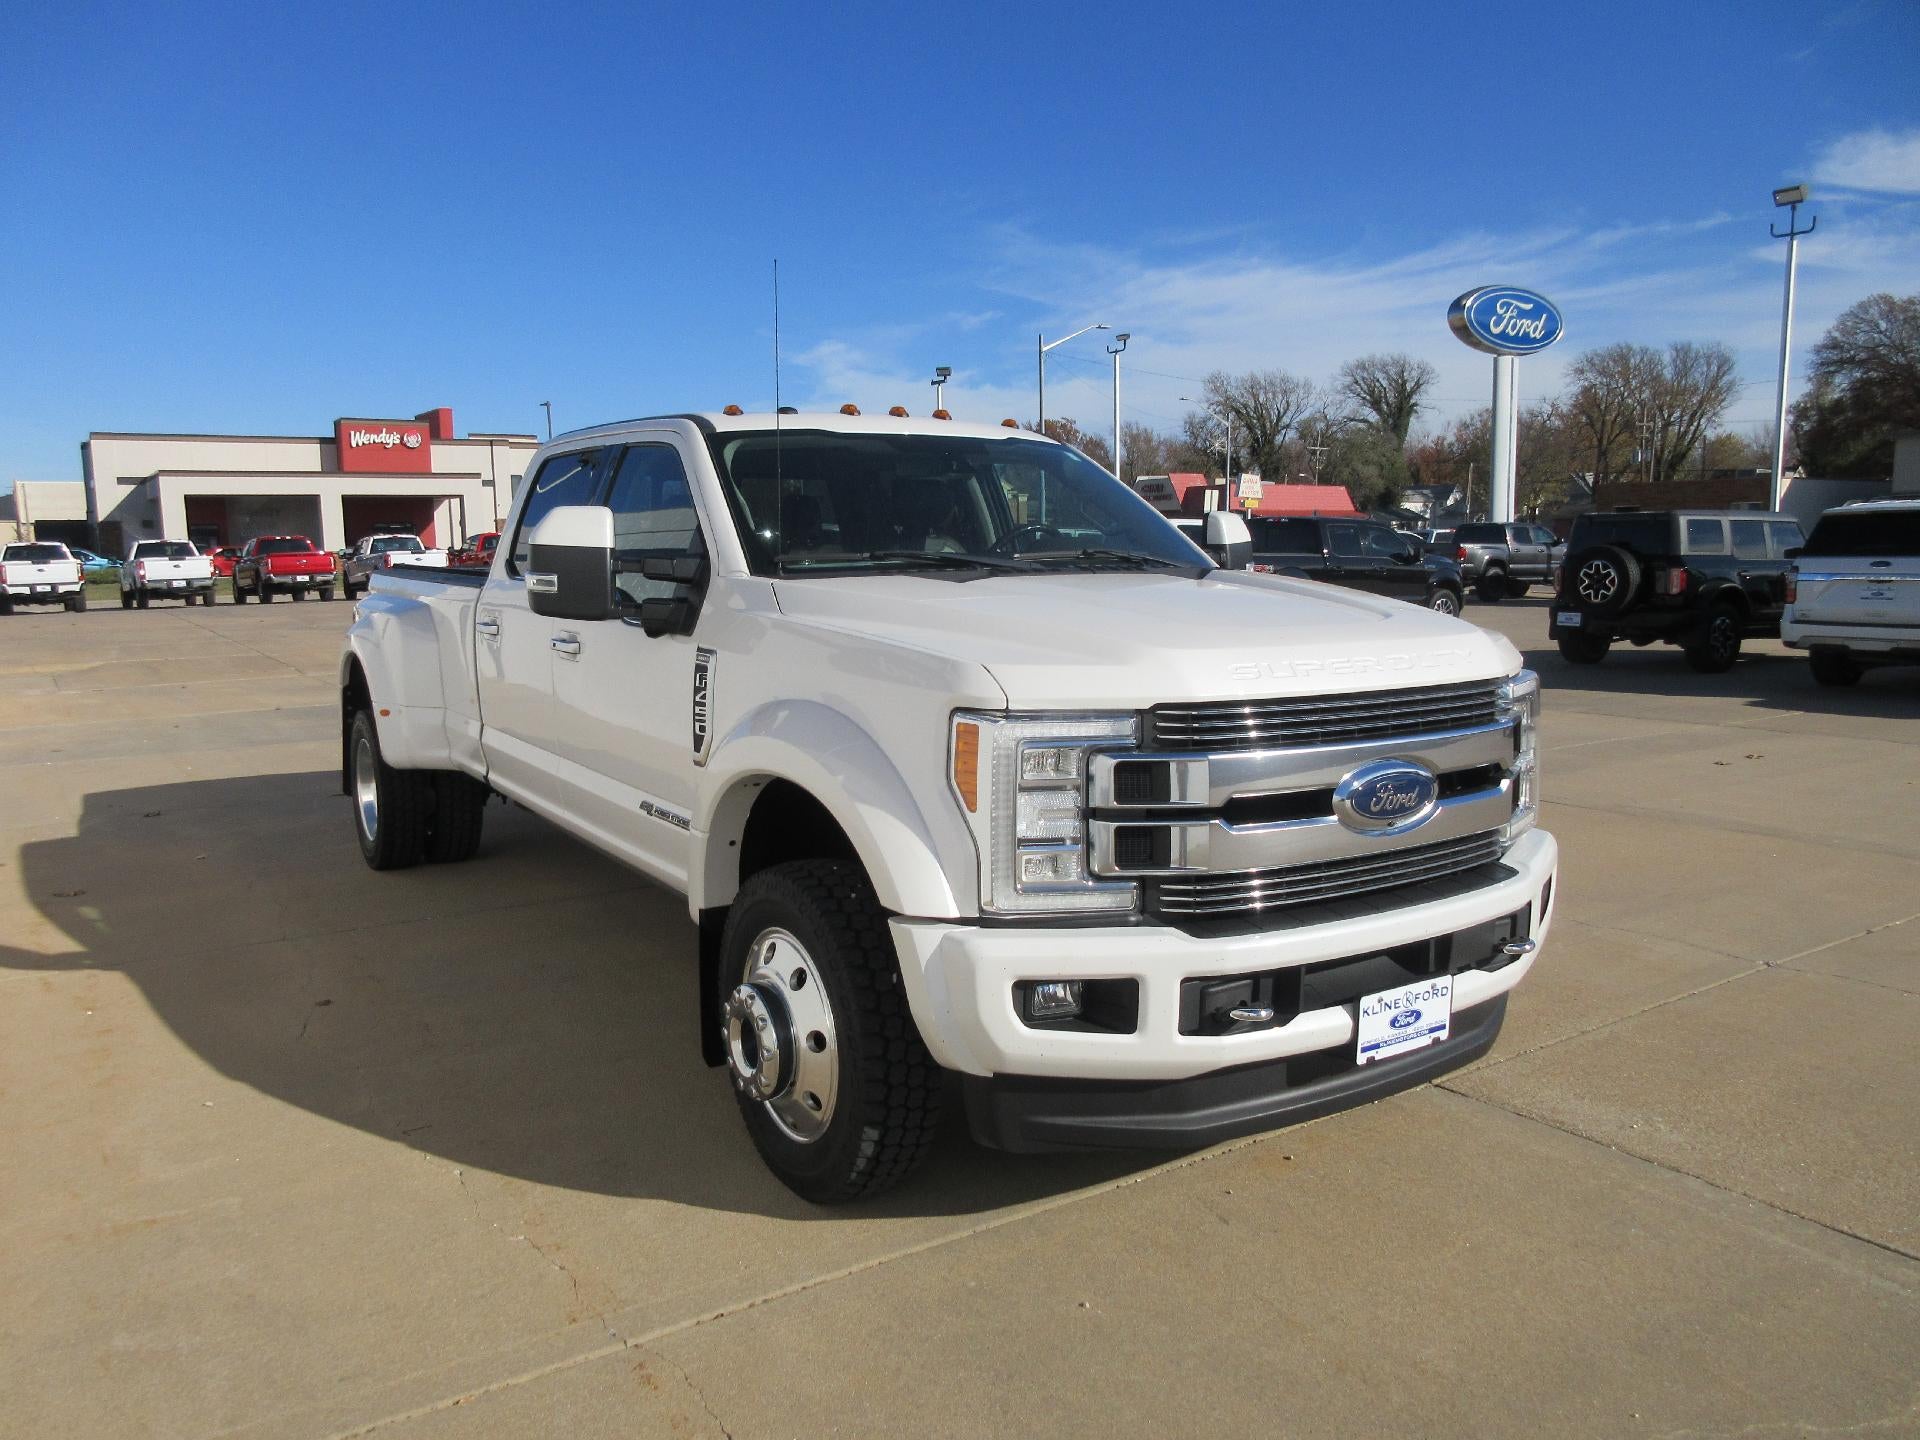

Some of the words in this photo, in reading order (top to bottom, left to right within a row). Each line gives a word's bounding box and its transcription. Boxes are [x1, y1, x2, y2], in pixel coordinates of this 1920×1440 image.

[1489, 298, 1548, 340] Ford
[350, 427, 401, 449] Wendy's
[1370, 780, 1420, 813] Ford
[1362, 998, 1402, 1018] KLINE
[1414, 985, 1449, 1004] FORD
[1394, 1011, 1417, 1028] Ford
